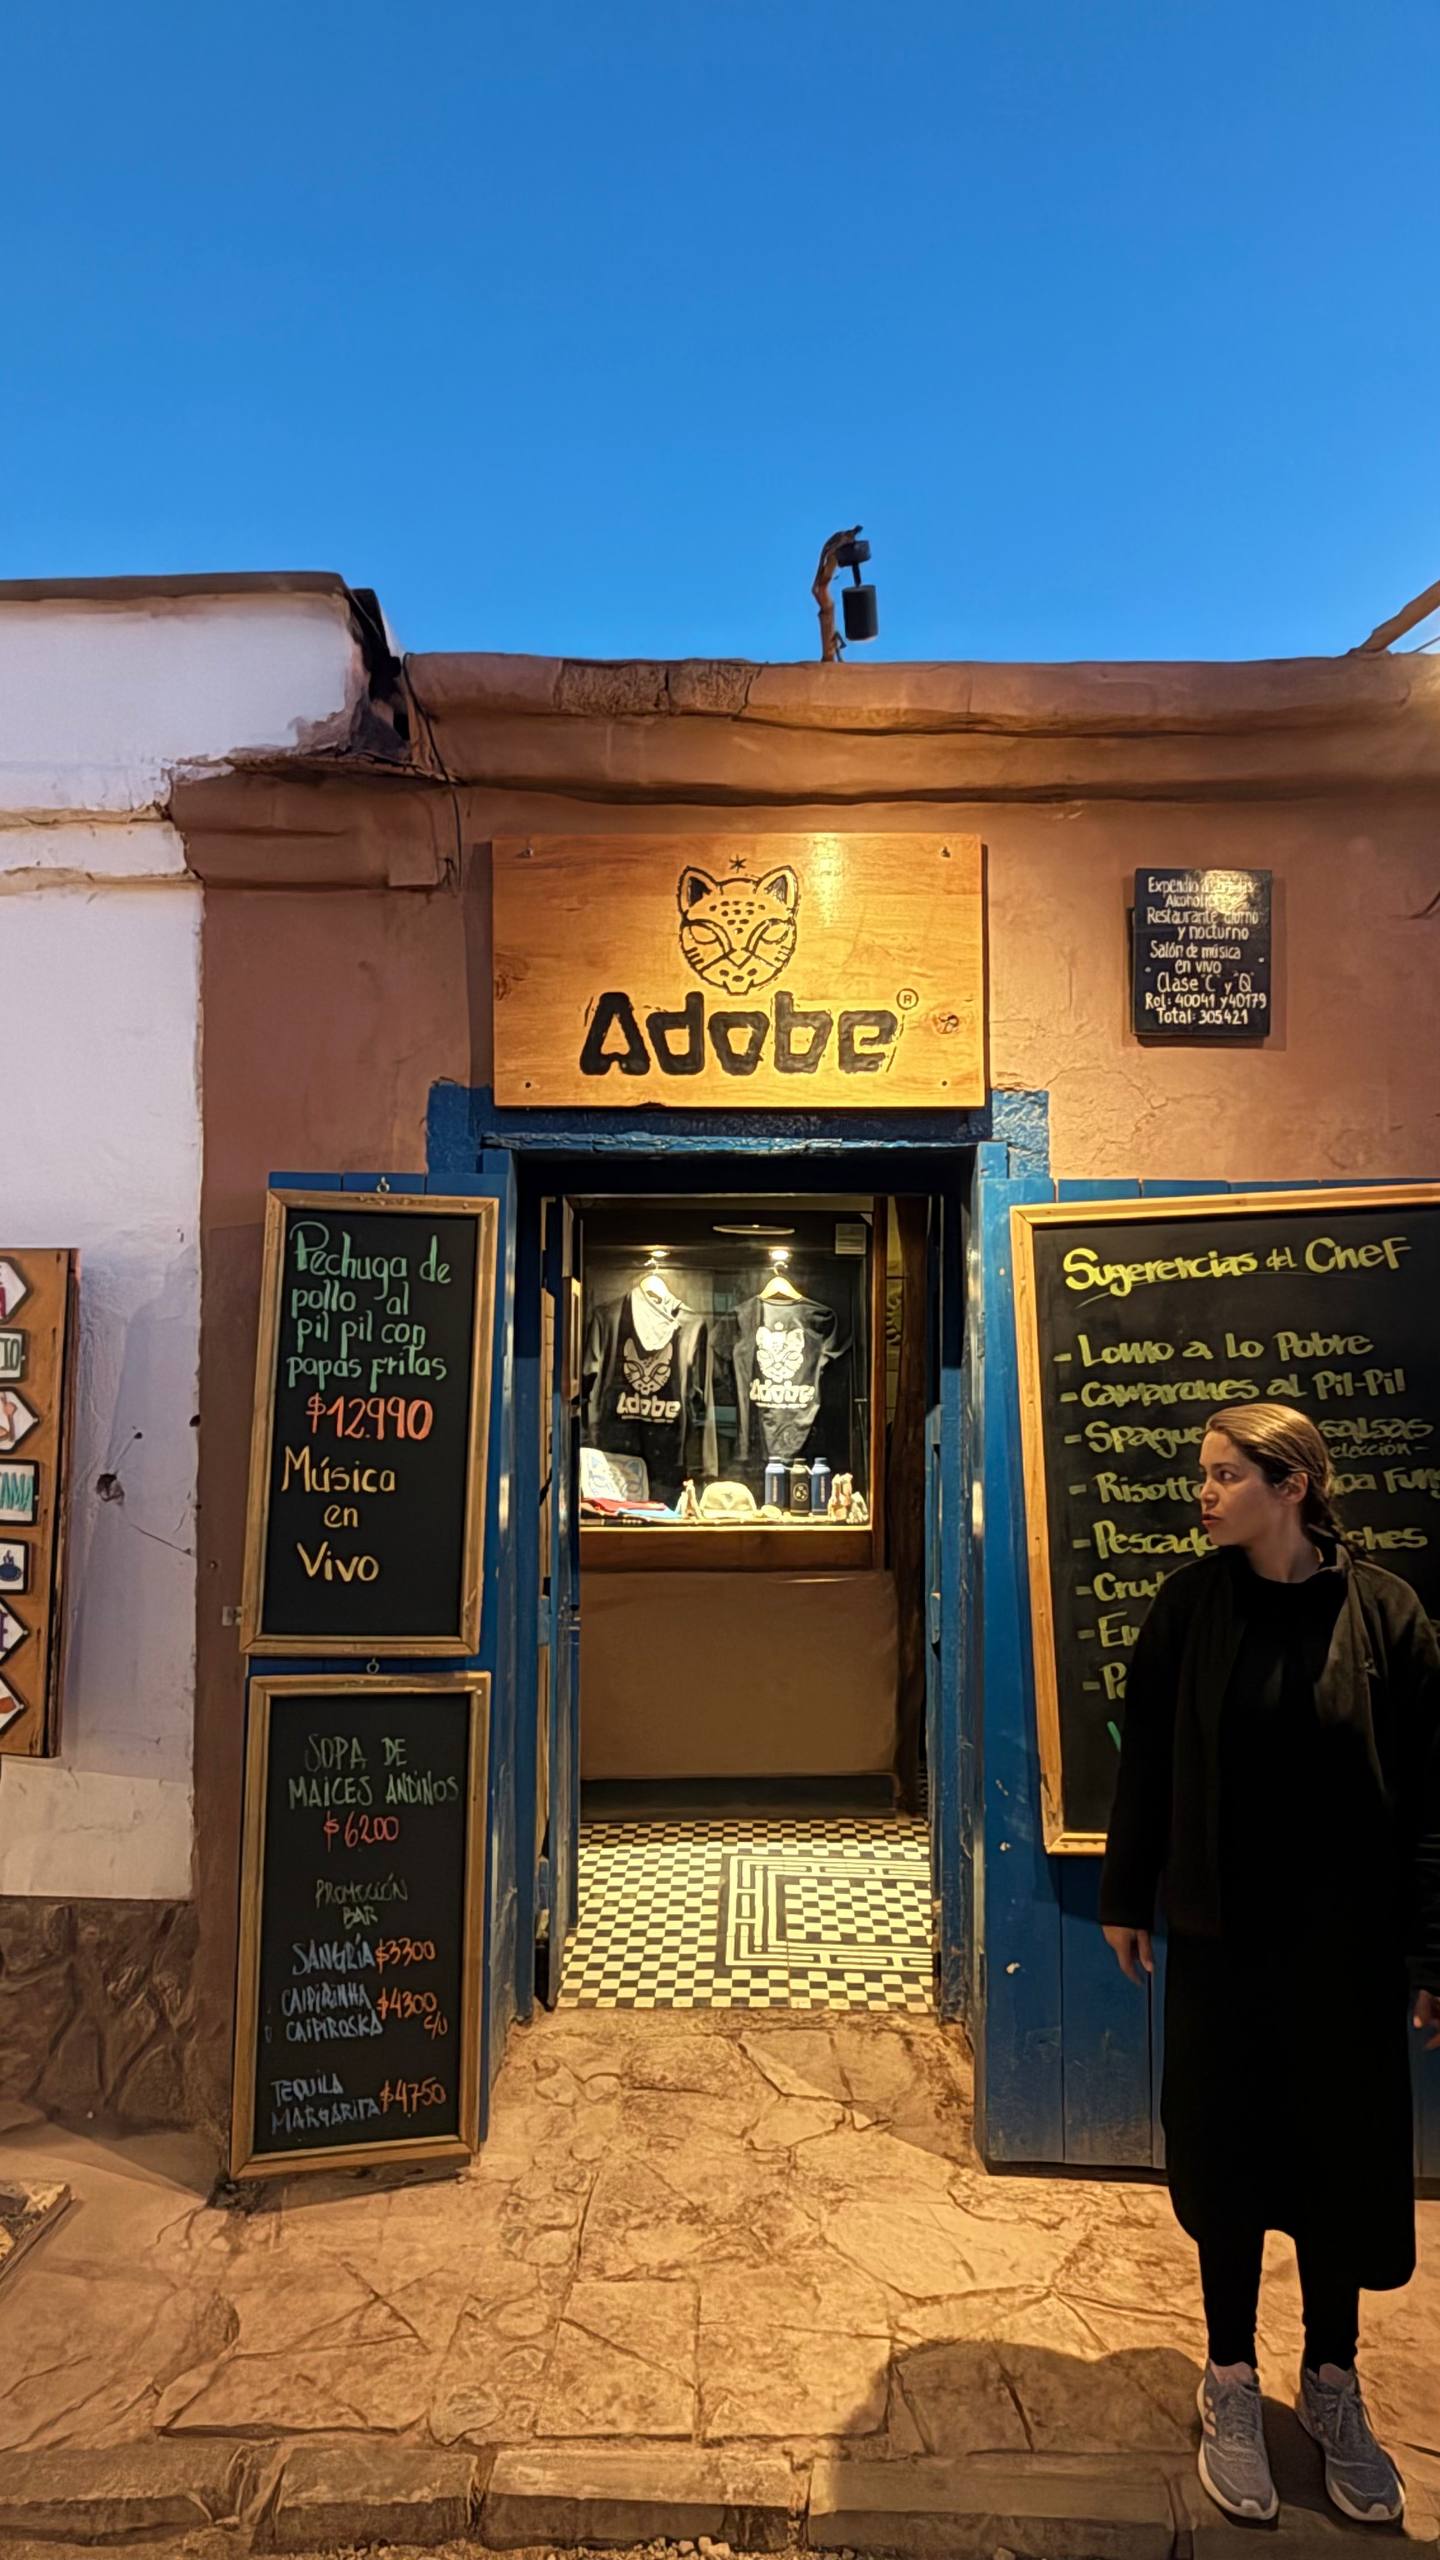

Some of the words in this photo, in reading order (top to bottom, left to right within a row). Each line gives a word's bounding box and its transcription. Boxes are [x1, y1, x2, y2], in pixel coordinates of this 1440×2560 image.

[1148, 876, 1199, 897] Expendio
[1147, 906, 1217, 924] Restaurante
[1177, 927, 1186, 941] y
[1189, 924, 1249, 940] nocturno
[1150, 940, 1183, 959] Salón
[1186, 945, 1199, 958] de
[1201, 944, 1241, 960] música
[1175, 960, 1191, 974] en
[1195, 959, 1222, 974] vivo
[1157, 971, 1199, 993] Clase
[1224, 982, 1232, 995] y
[1145, 992, 1171, 1010] Rol:
[1174, 993, 1215, 1008] 40041
[1157, 1009, 1196, 1025] Total:
[1198, 1010, 1249, 1025] 305421
[579, 991, 900, 1076] Adobe
[289, 1222, 407, 1300] Pechuga
[420, 1235, 451, 1284] de
[1063, 1247, 1258, 1297] Sugerencias
[1266, 1247, 1297, 1271] del
[292, 1280, 357, 1320] pollo
[386, 1282, 410, 1317] al
[297, 1313, 329, 1353] pil
[340, 1310, 373, 1359] pil
[381, 1323, 425, 1350] con
[1182, 1341, 1214, 1360] a
[1274, 1331, 1375, 1361] Pobre
[287, 1356, 362, 1390] papas
[1267, 1374, 1308, 1397] al
[1313, 1369, 1405, 1399] Pil-Pil
[282, 1445, 396, 1493] Música
[324, 1506, 358, 1528] en
[297, 1542, 379, 1583] Vivo
[304, 1733, 368, 1772] SOPA
[381, 1737, 408, 1766] DE
[288, 1776, 373, 1810] MAICES
[385, 1770, 459, 1805] ANDINOS
[315, 1873, 408, 1908] PROMOCIÓN
[343, 1905, 378, 1930] BAR
[292, 1932, 376, 1975] SANGRÍA
[375, 1937, 436, 1975] $3300
[281, 1981, 373, 2016] CAIPIRINHA
[377, 1986, 437, 2020] $4300
[270, 2073, 344, 2107] TEQUILA
[271, 2098, 381, 2135] MARGARITA
